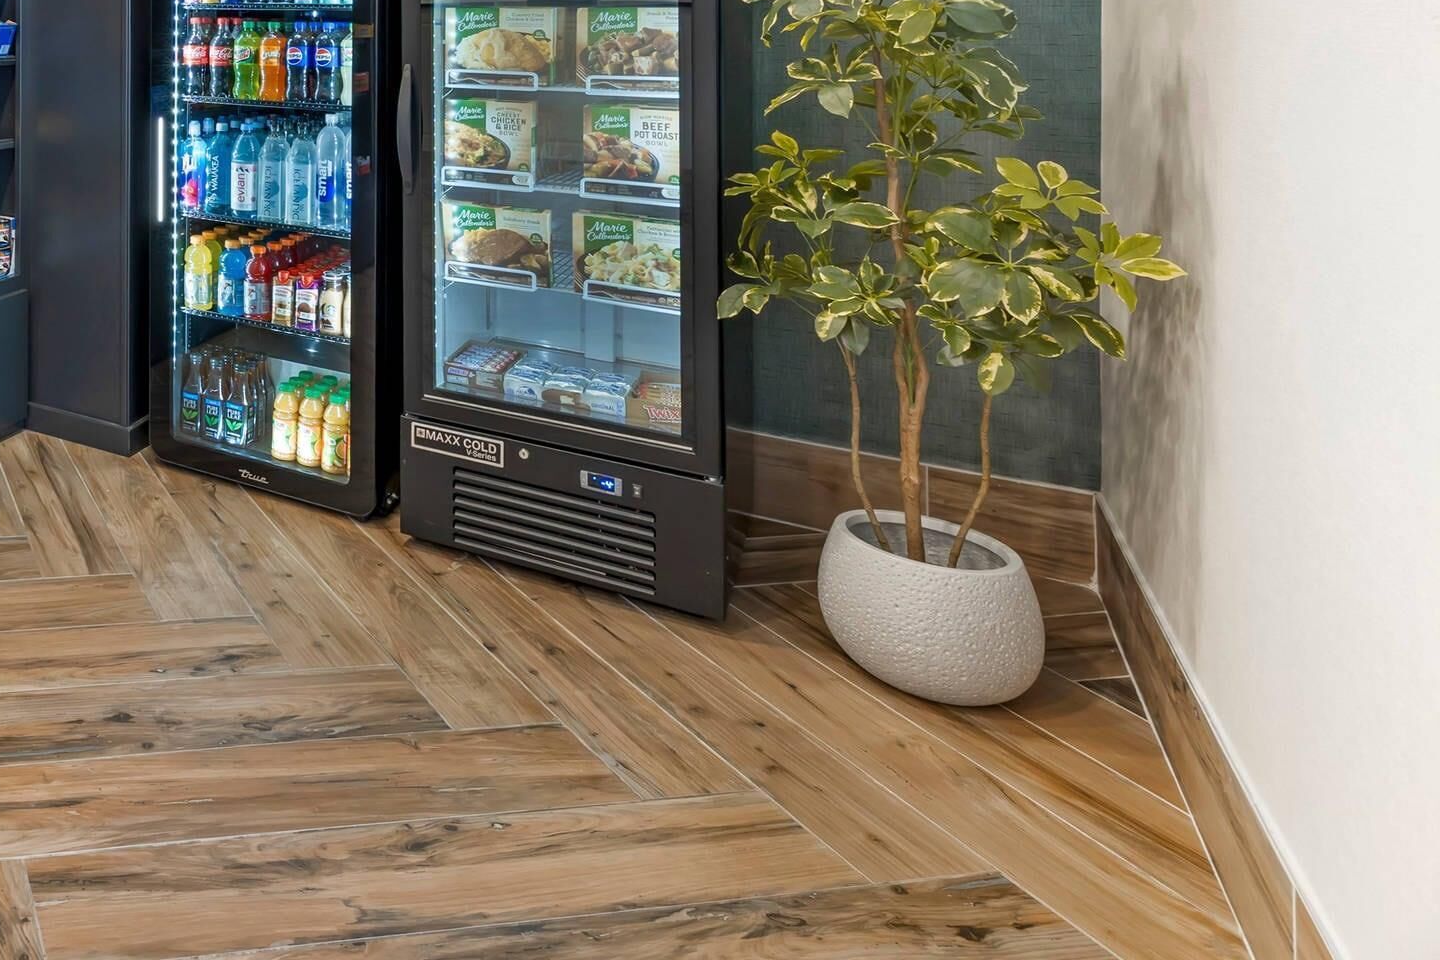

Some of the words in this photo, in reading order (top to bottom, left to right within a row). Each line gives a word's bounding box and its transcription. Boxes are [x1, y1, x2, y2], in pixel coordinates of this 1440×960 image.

[459, 11, 495, 22] Marie
[593, 11, 632, 23] Marie
[459, 106, 482, 114] Marie
[491, 117, 526, 125] CHICKEN
[642, 122, 670, 131] BEEF
[634, 131, 650, 139] POT
[651, 132, 679, 140] ROAST
[238, 172, 246, 202] evian
[459, 209, 491, 220] Marie
[587, 221, 627, 232] Marie
[644, 403, 681, 421] Twix
[425, 430, 460, 446] MAXX
[463, 439, 497, 455] COLD
[465, 448, 497, 462] V-Series
